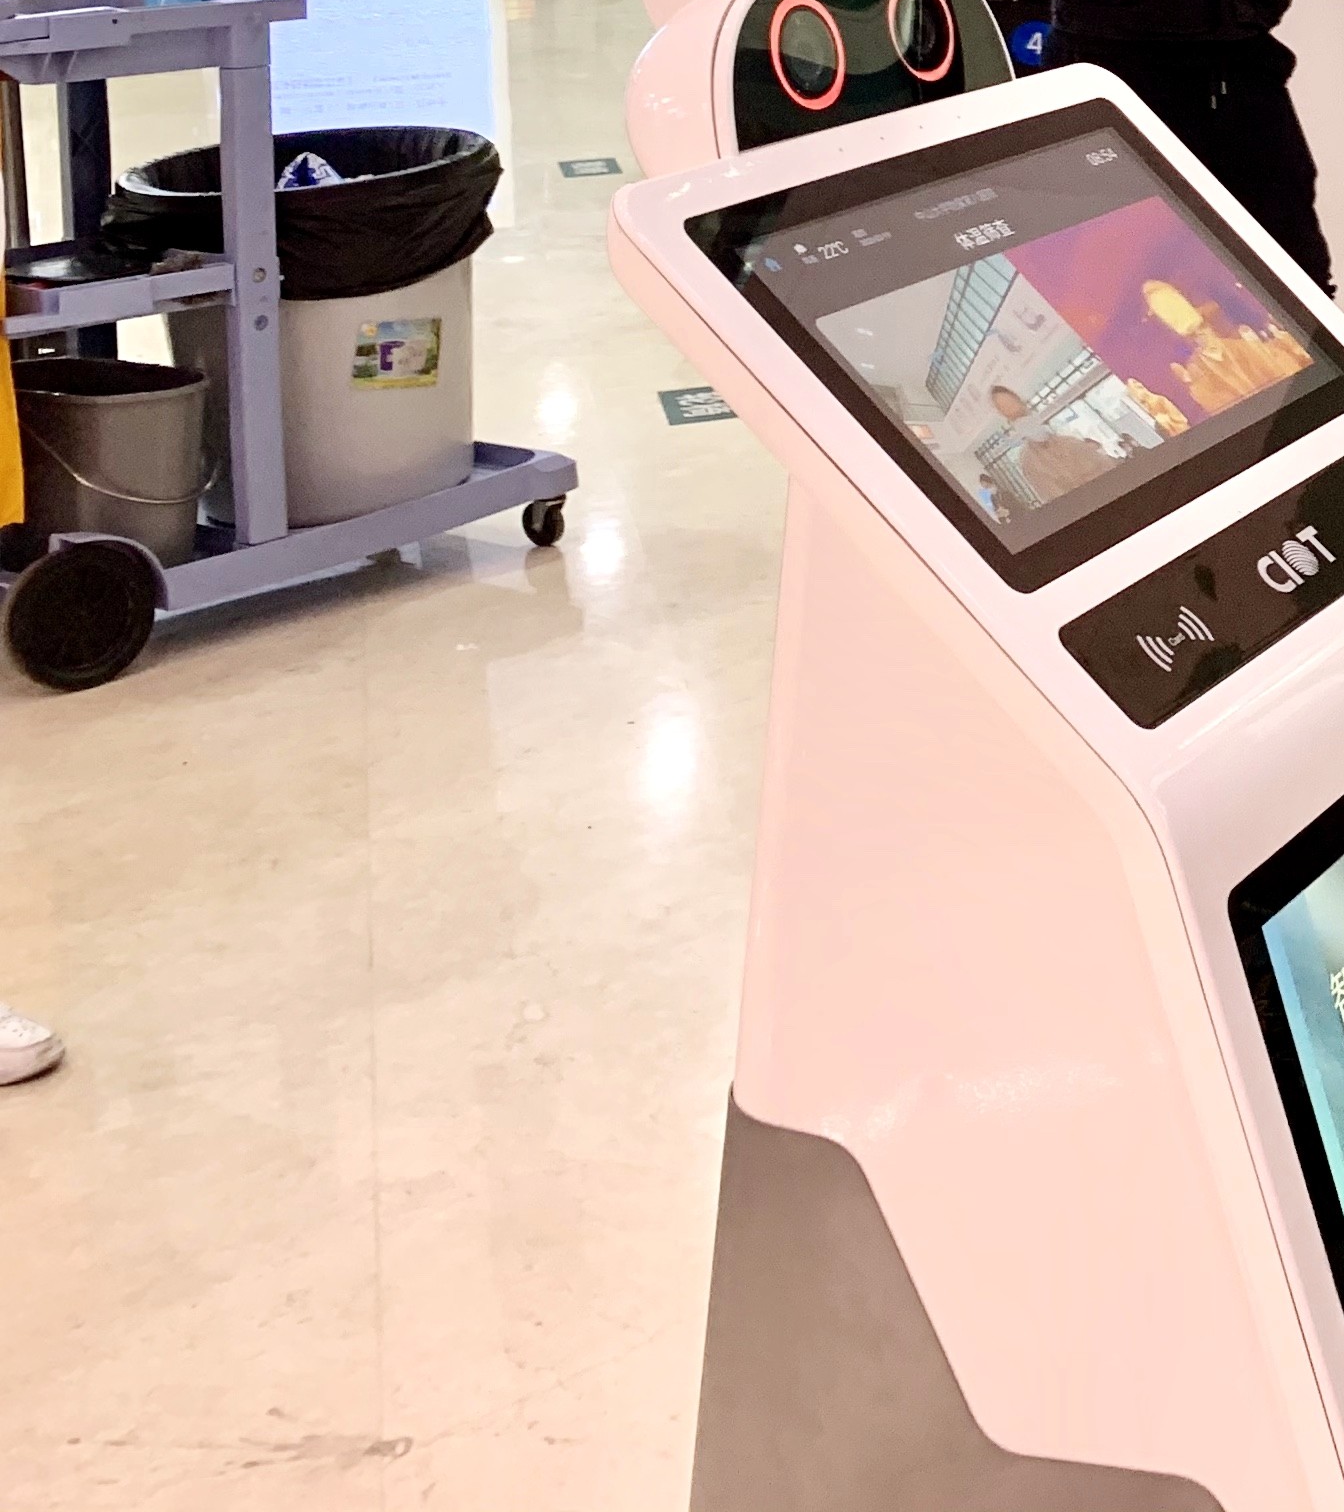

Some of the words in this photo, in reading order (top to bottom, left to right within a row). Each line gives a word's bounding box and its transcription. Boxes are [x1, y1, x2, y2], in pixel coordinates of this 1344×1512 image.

[1026, 31, 1043, 55] 4
[952, 218, 1016, 252] 体温筛查
